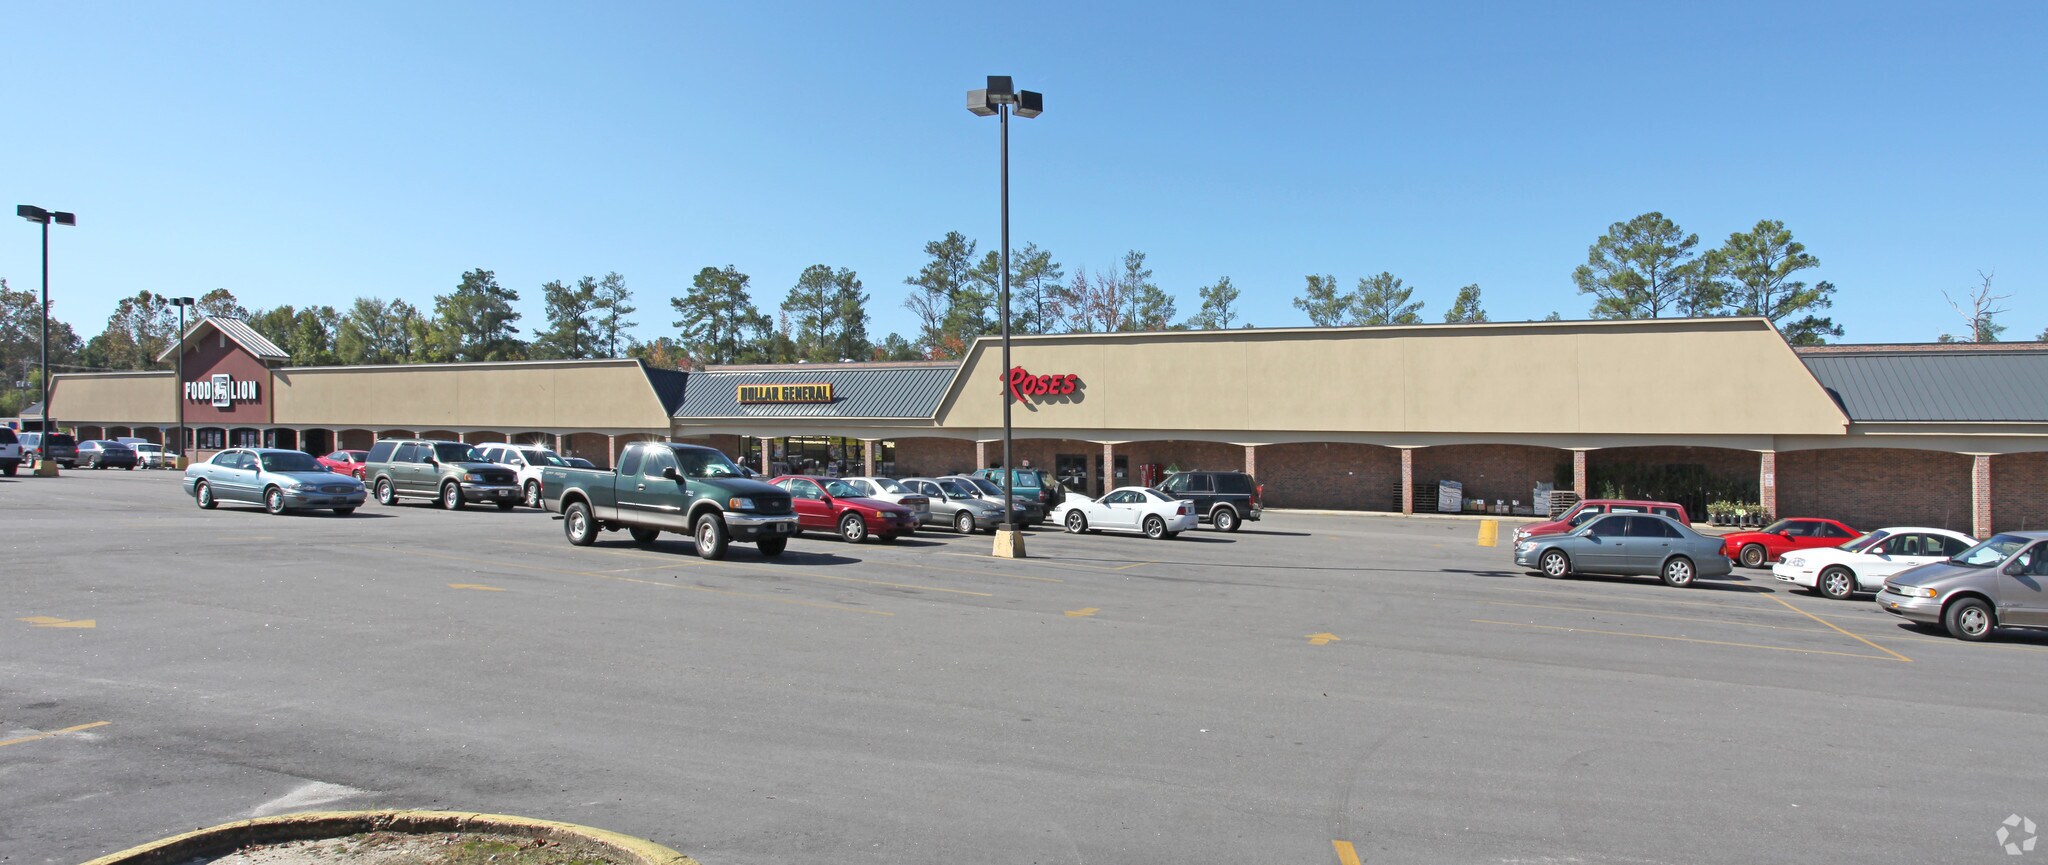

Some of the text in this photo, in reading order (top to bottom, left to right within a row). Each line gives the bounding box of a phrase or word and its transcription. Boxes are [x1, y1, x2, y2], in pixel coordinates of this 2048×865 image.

[185, 381, 256, 400] FOOD LION
[740, 386, 829, 401] DOLLAR GENERAL
